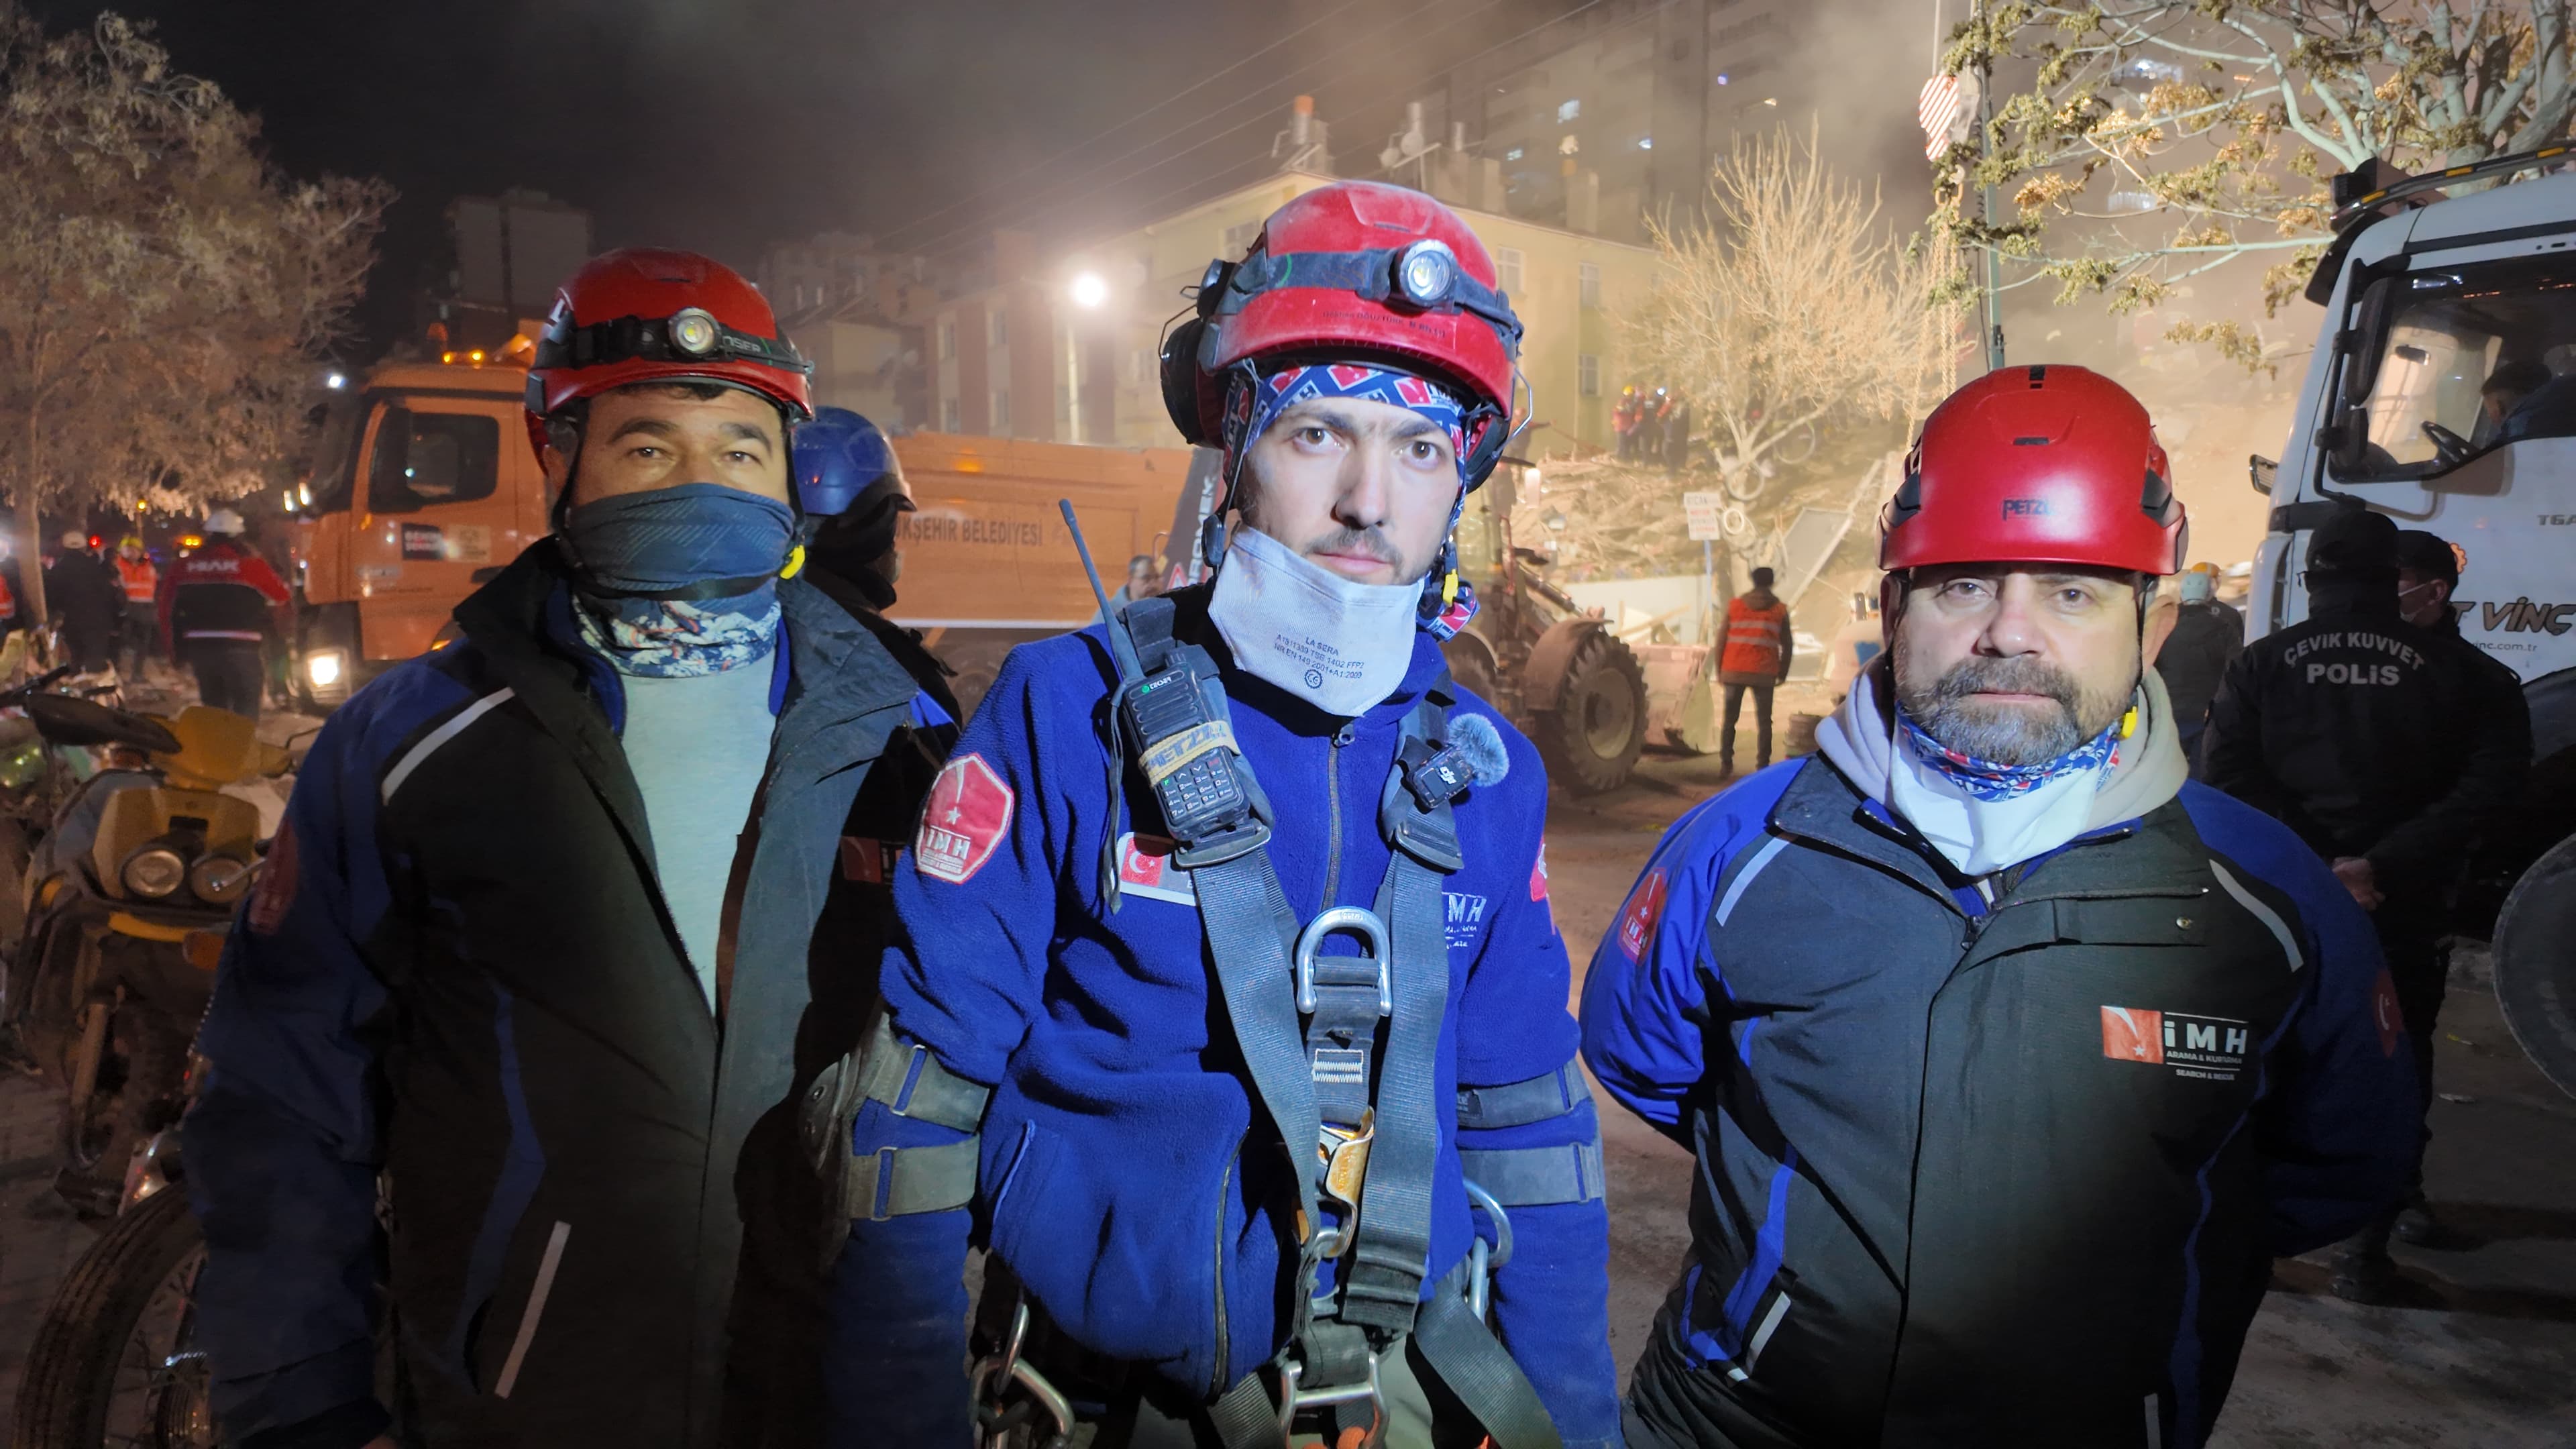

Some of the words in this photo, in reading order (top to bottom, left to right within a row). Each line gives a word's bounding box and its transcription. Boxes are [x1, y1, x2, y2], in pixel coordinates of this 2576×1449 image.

[962, 517, 1043, 547] BELEDİYESİ
[2483, 596, 2576, 636] VİNÇ
[1274, 643, 1285, 654] NR
[1286, 648, 1297, 659] EN
[1305, 637, 1316, 647] LA
[1317, 640, 1339, 656] SERA
[2347, 632, 2425, 670] KUVVET
[1311, 649, 1326, 661] TSE
[1328, 657, 1345, 668] 1402
[1346, 661, 1364, 669] FFP2
[2306, 663, 2401, 686] POLİS
[1448, 894, 1487, 923] MH
[2166, 1051, 2198, 1061] ARAMA
